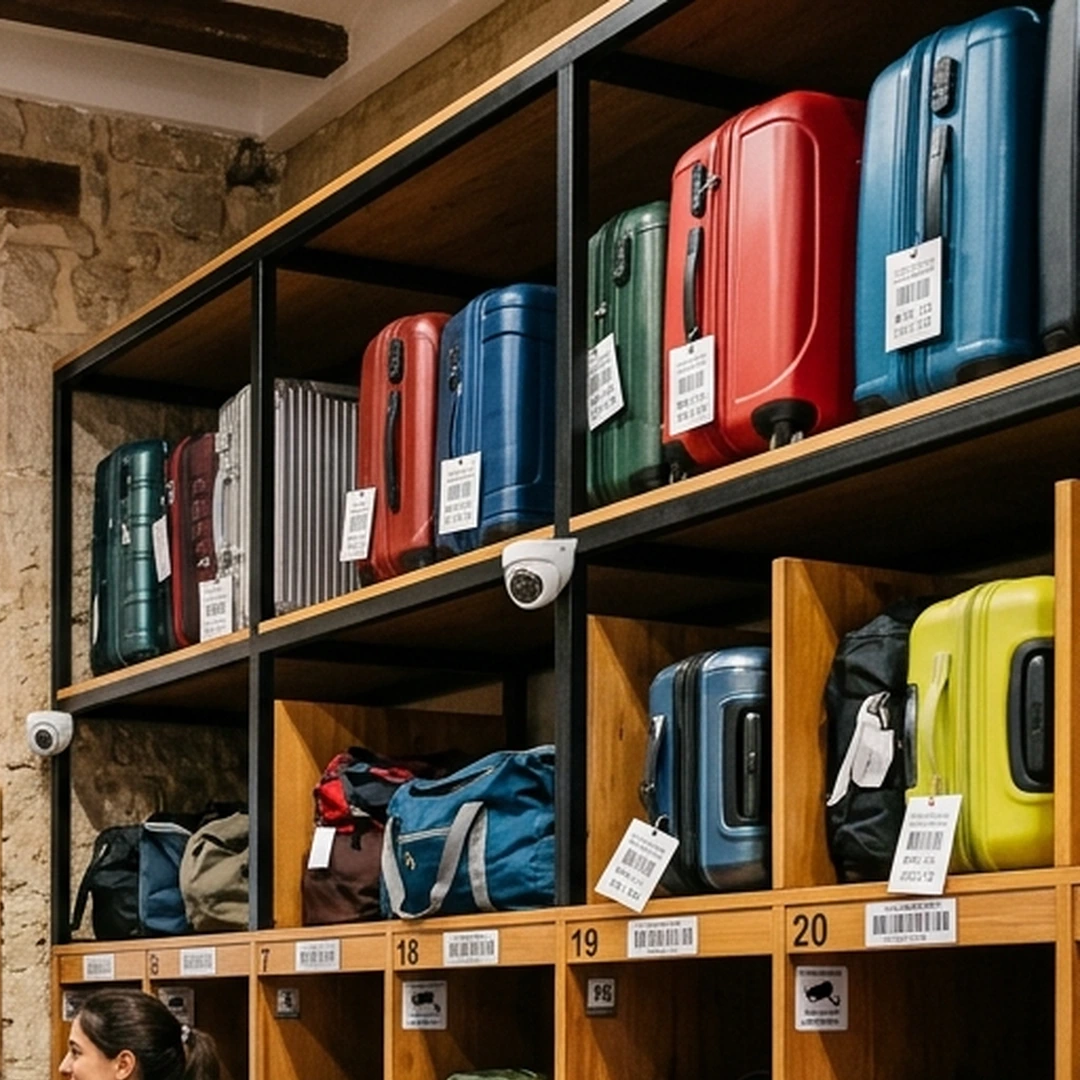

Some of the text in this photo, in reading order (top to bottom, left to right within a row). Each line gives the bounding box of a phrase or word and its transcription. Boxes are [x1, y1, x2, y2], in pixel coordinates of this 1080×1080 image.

[571, 928, 599, 957] 19
[793, 913, 828, 947] 20
[396, 939, 419, 966] 18
